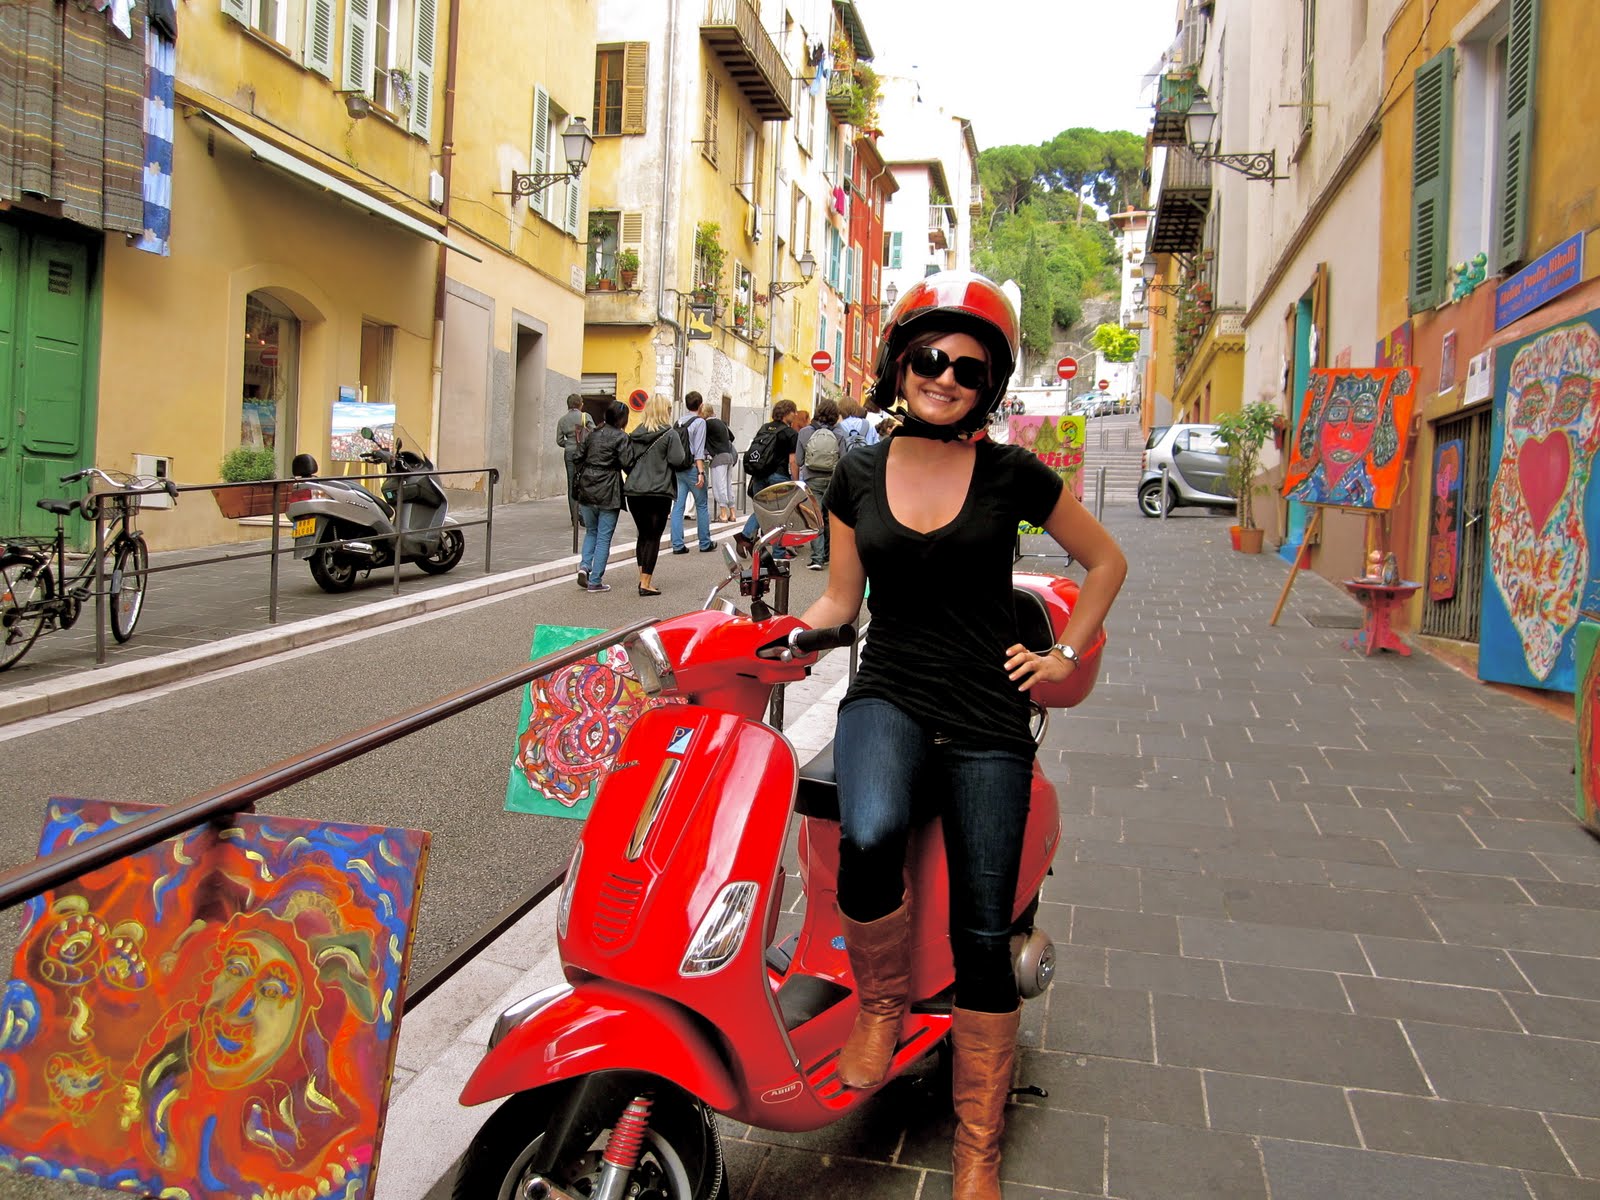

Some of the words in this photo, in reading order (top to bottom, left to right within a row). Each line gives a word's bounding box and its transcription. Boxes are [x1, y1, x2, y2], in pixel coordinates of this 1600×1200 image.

[1505, 541, 1563, 582] LOVE
[1511, 582, 1573, 625] NICE
[771, 1084, 796, 1096] ABUS
